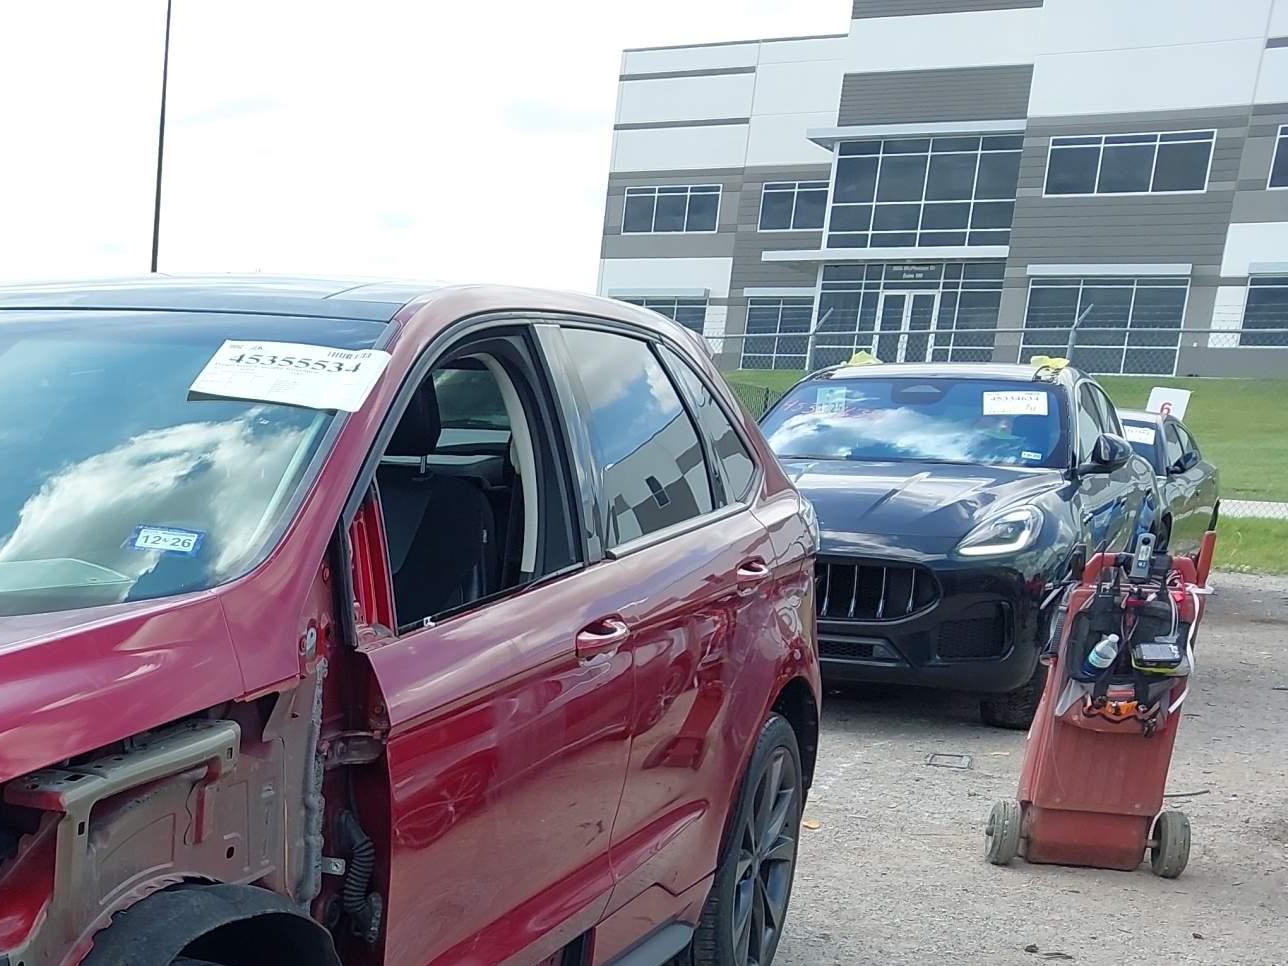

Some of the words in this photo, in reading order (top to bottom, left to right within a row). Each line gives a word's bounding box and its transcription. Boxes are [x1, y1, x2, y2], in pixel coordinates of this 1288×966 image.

[228, 353, 363, 374] 45355534
[142, 535, 162, 545] 12
[170, 537, 193, 548] 26
